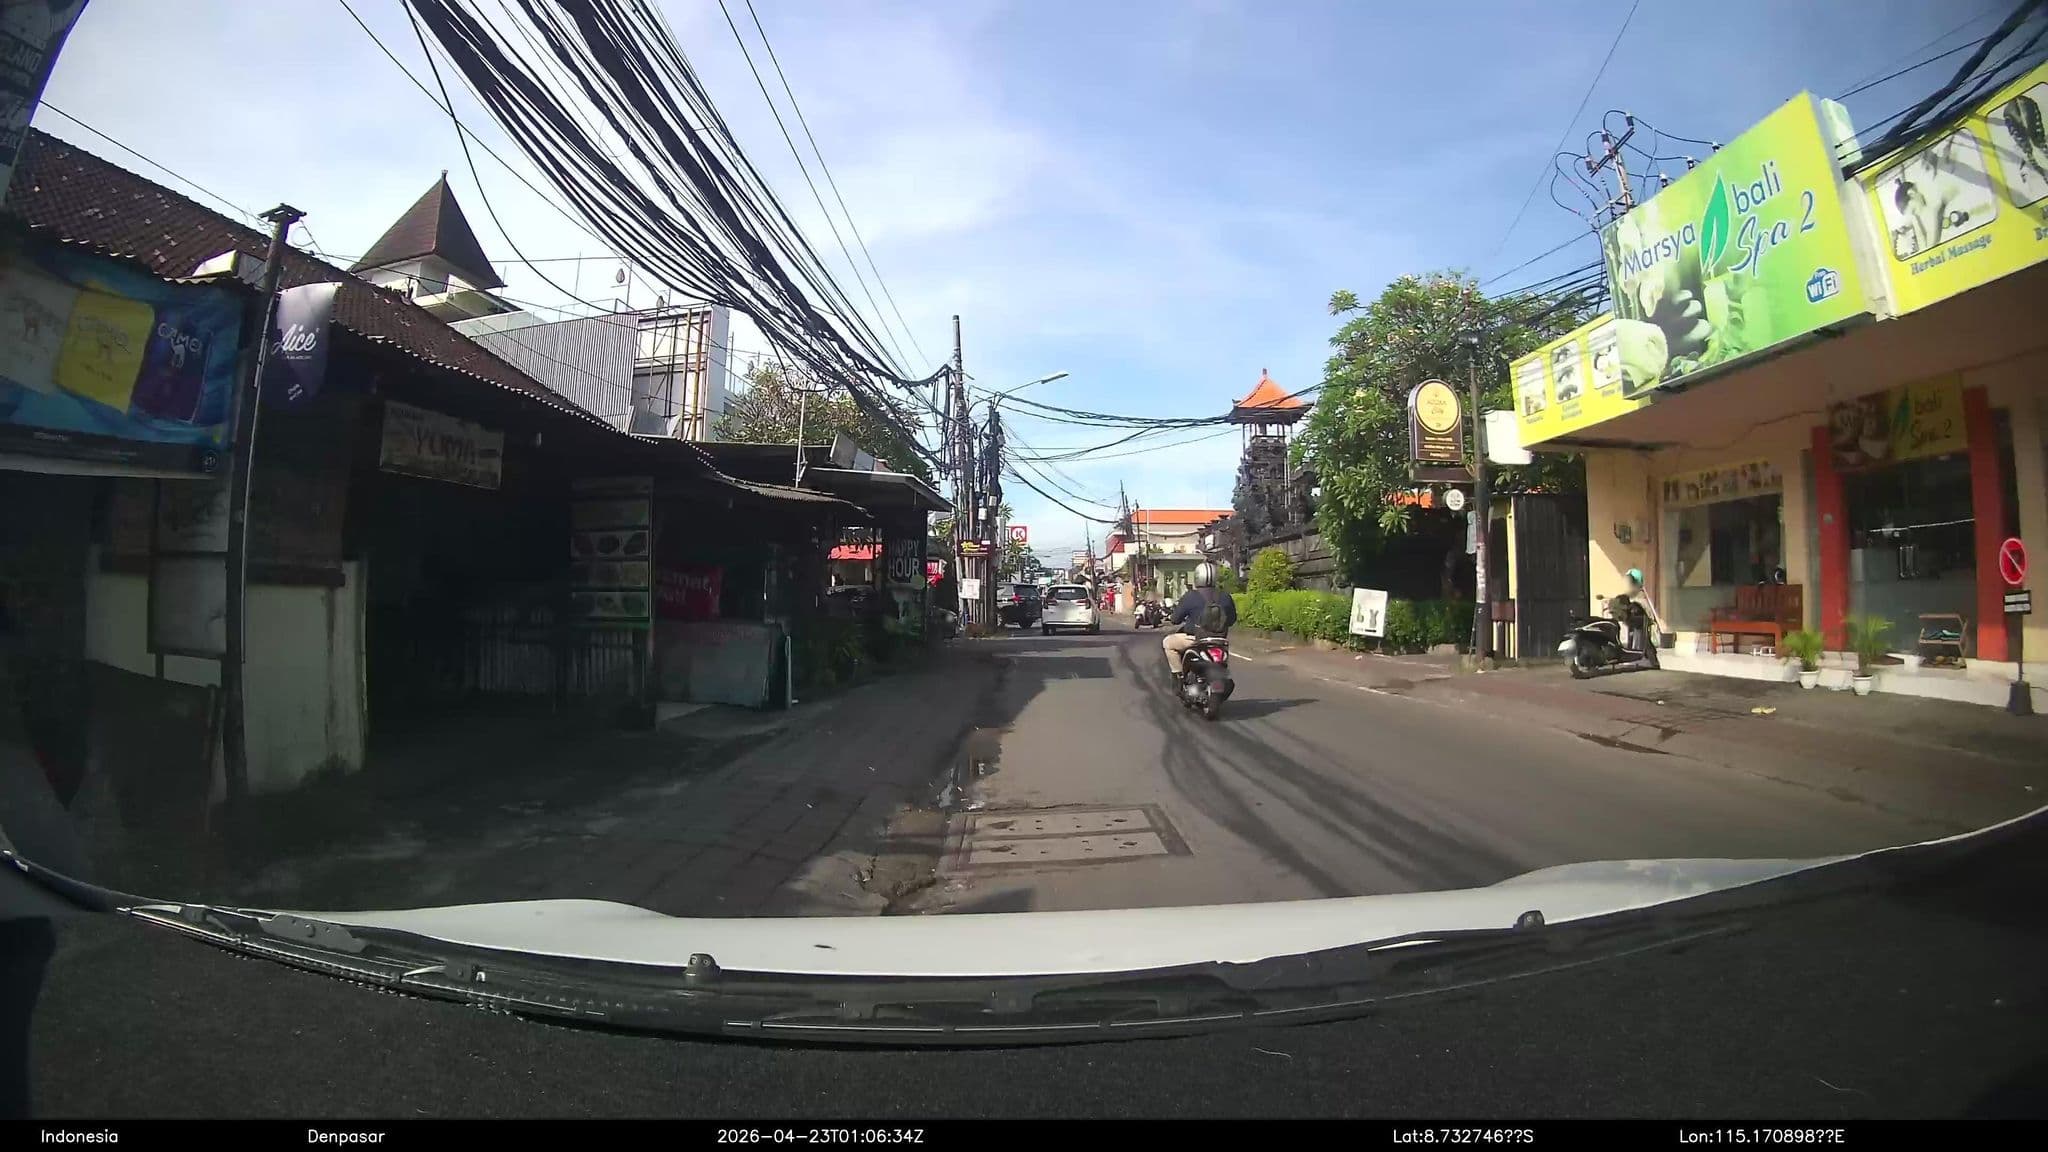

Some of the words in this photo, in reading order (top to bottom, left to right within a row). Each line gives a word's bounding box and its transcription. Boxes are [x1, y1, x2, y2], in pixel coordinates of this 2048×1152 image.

[1732, 160, 1781, 214] bali
[1728, 216, 1789, 276] Spa
[1800, 190, 1816, 234] 2
[1623, 223, 1696, 279] Marsya
[1911, 252, 1946, 275] Herbal
[1948, 234, 1992, 260] Massage
[272, 323, 317, 355] Aice
[1915, 388, 1943, 415] bali
[1944, 418, 1952, 439] 2
[889, 539, 919, 557] HAPPY
[889, 558, 920, 577] HOUR
